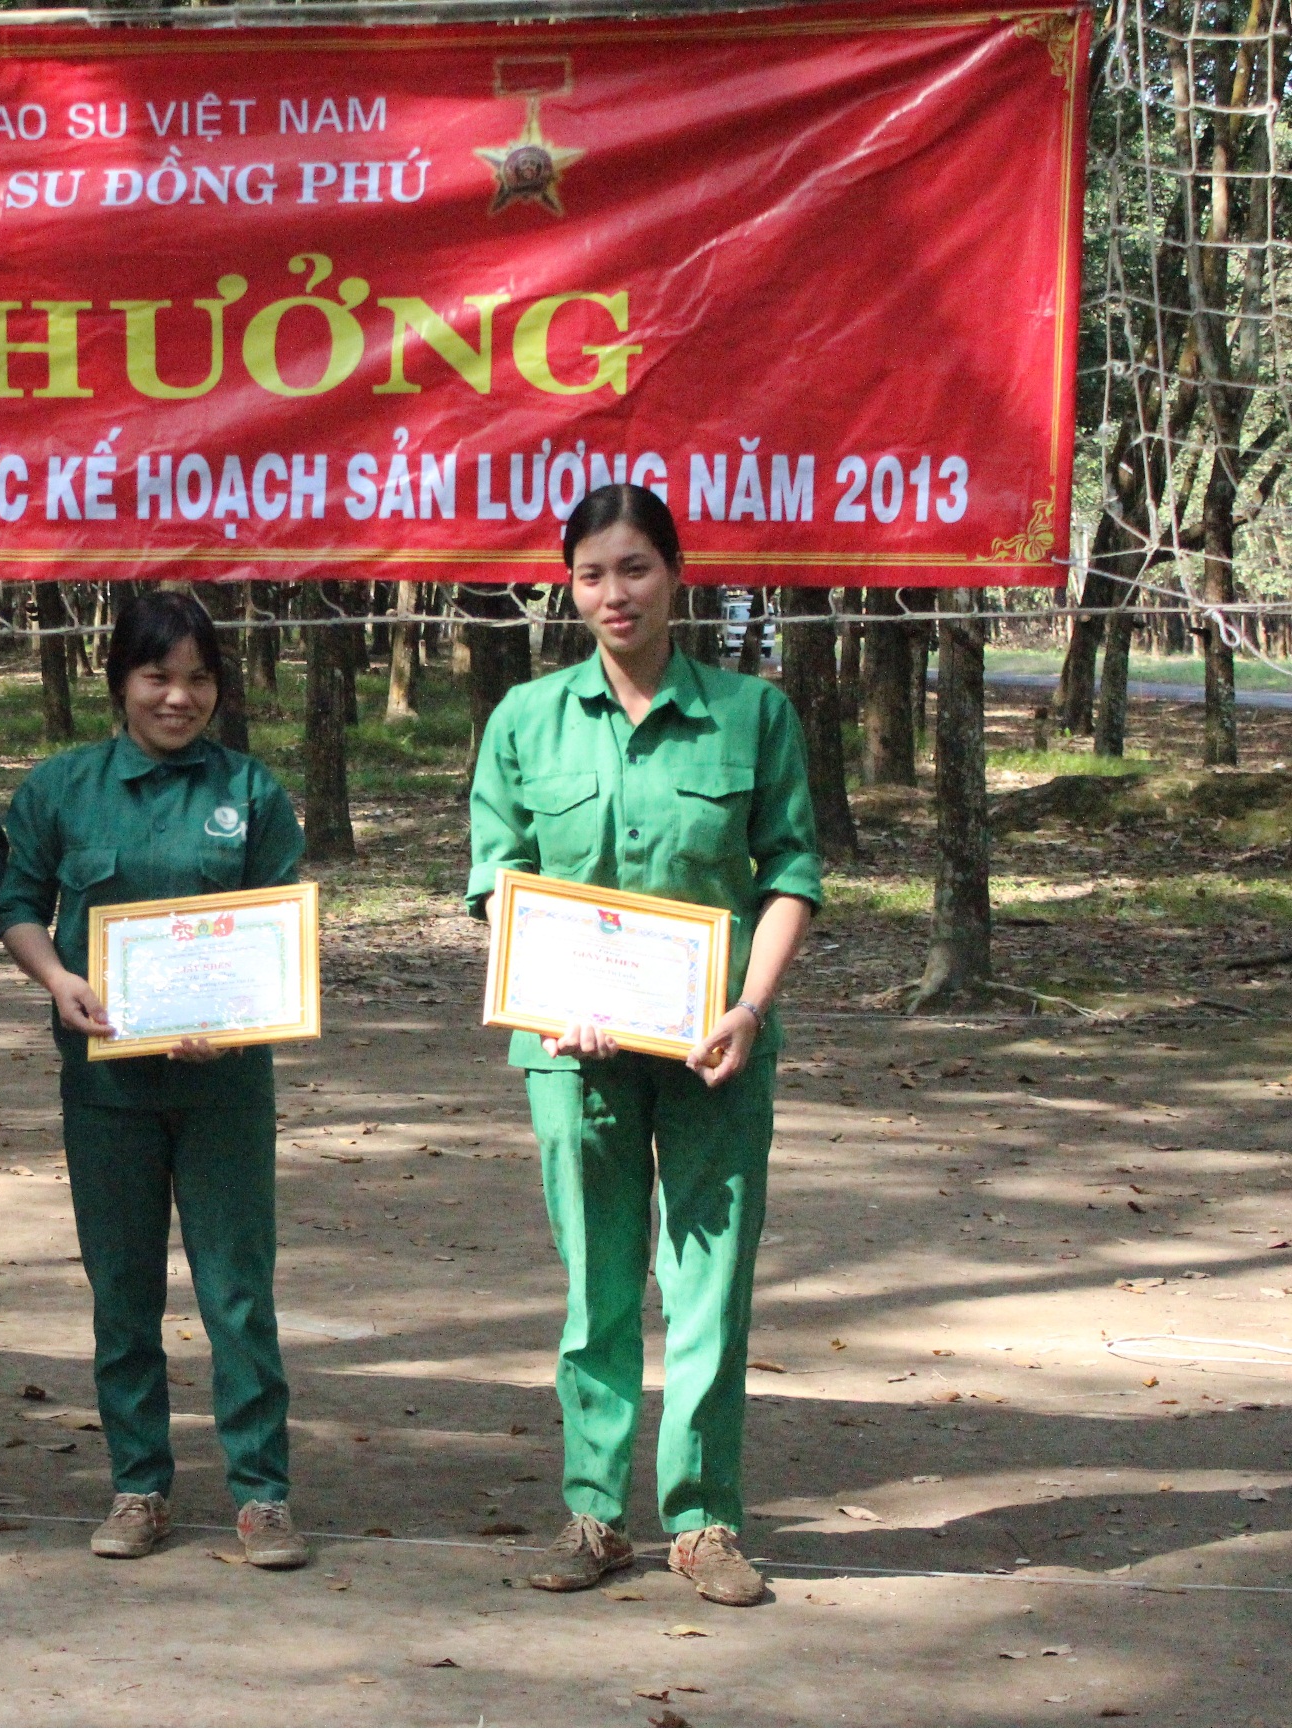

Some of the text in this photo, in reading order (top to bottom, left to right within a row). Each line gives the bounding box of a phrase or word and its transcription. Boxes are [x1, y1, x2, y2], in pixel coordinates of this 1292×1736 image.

[67, 102, 128, 140] SU
[146, 93, 257, 142] VIỆT
[279, 96, 387, 135] NAM
[5, 170, 86, 210] SU
[103, 146, 278, 207] ĐỒNG
[296, 147, 432, 204] PHÚ
[46, 426, 123, 520] KẾ
[136, 452, 328, 541] HOẠCH
[343, 426, 458, 521] SẢN
[688, 436, 816, 522] NĂM
[834, 455, 970, 524] 2013
